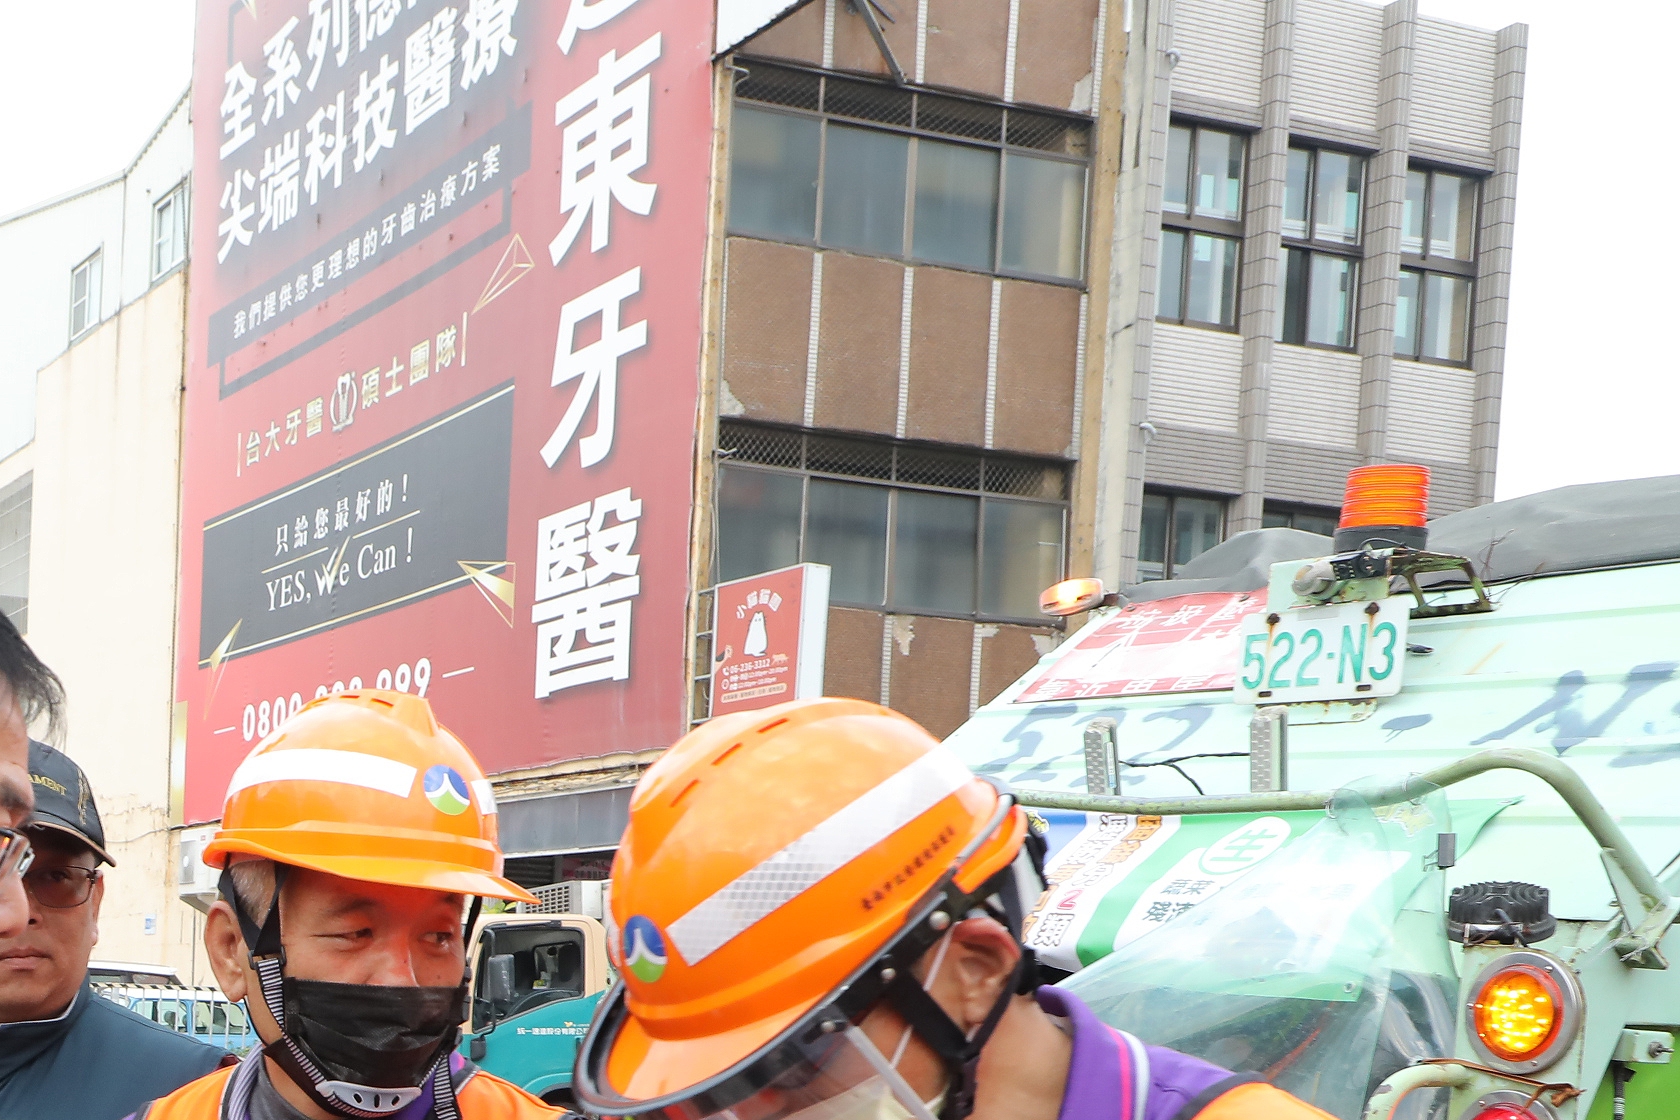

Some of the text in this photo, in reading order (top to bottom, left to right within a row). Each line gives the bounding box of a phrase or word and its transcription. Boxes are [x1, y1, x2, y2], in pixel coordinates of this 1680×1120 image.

[217, 0, 519, 264] 尖端科技醫療
[219, 0, 420, 160] 全系列
[233, 144, 501, 338] 我們提供您更理想的牙齒治療方案
[246, 329, 456, 467] 台大牙醫 碩士團隊
[532, 0, 662, 699] 東牙醫
[266, 570, 311, 612] YES,
[357, 543, 396, 579] Can
[1240, 620, 1397, 691] 522-N3
